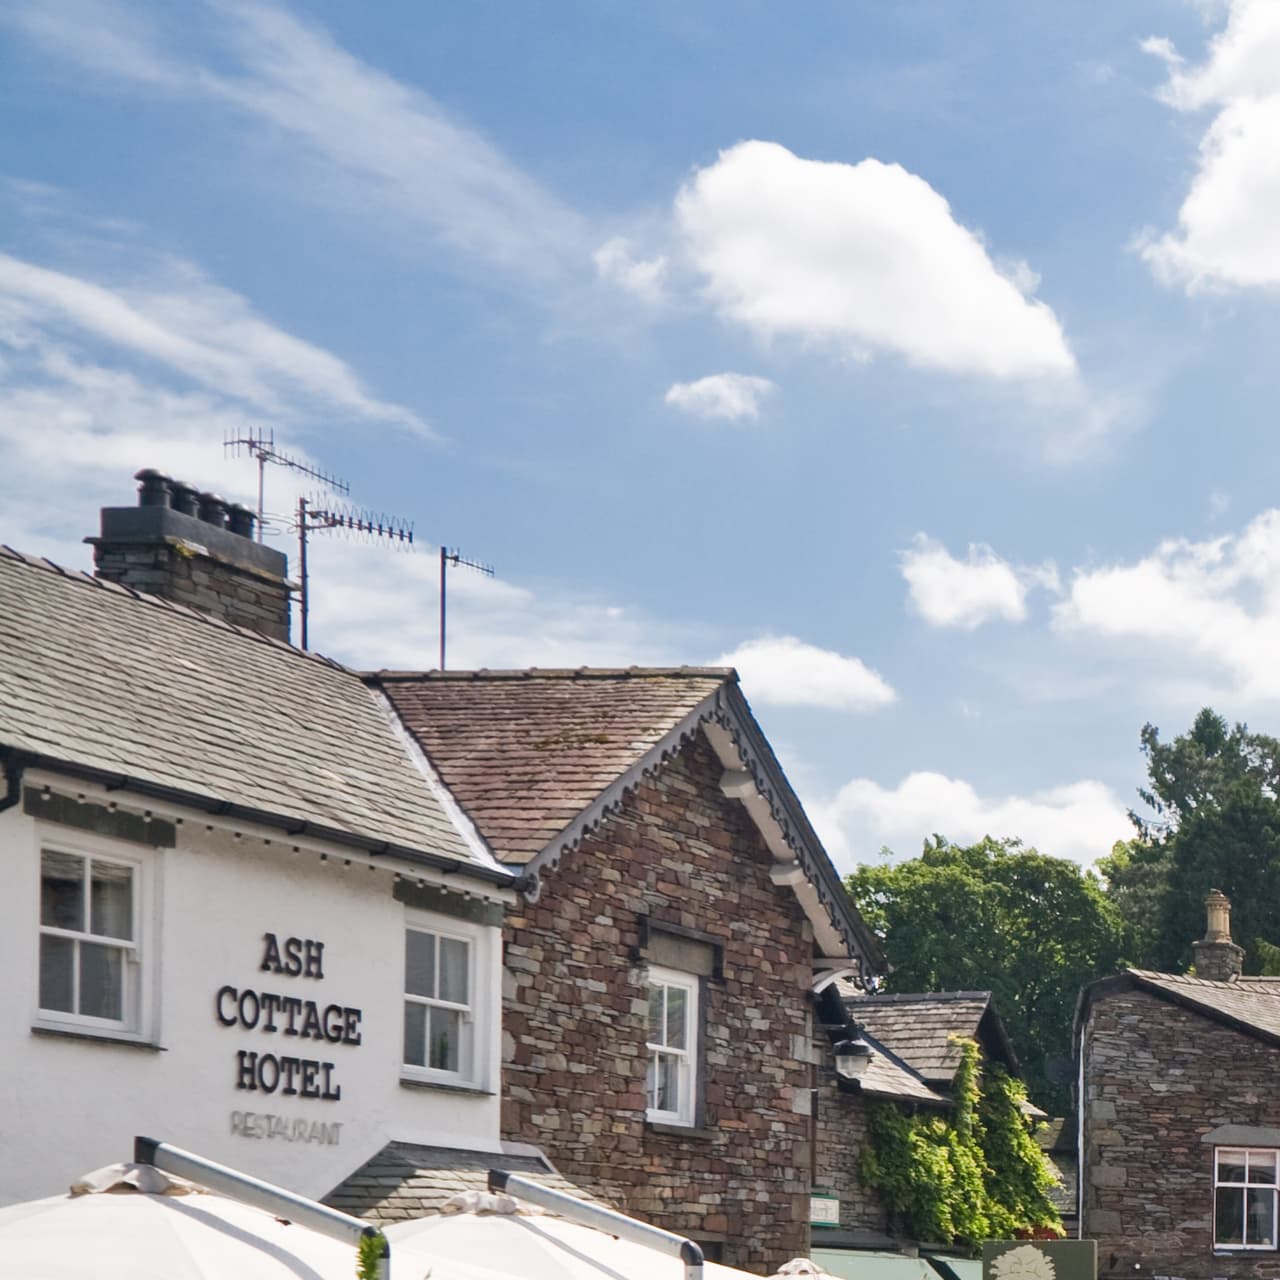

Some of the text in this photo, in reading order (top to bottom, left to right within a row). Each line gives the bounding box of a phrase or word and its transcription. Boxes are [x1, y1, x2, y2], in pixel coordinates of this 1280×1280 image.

[261, 932, 325, 979] ASH
[216, 985, 362, 1046] COTTAGE
[236, 1050, 341, 1101] HOTEL
[230, 1110, 344, 1146] RESTAURANT
